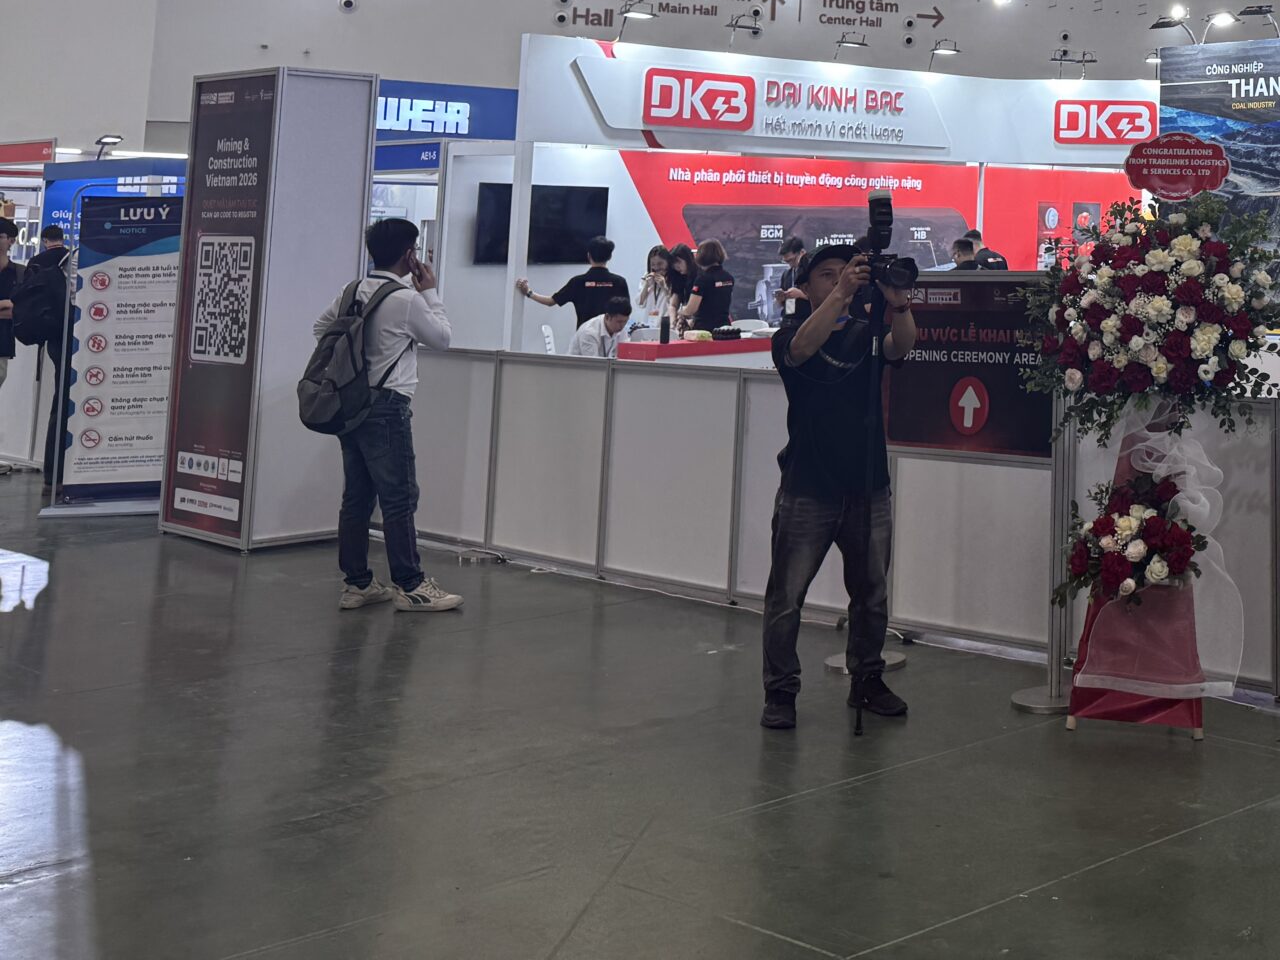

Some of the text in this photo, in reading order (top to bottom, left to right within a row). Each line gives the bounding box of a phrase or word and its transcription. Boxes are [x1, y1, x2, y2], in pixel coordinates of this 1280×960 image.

[572, 7, 614, 28] Hall
[658, 2, 882, 28] Main Hall Center Hall
[1206, 61, 1264, 76] CÔNG NGHIỆP
[809, 84, 857, 111] KINH
[1232, 101, 1276, 110] COAL INDUSTRY
[376, 96, 470, 134] WEIR
[216, 138, 250, 154] Mining &
[1142, 148, 1213, 156] CONGRATULATIONS
[208, 155, 258, 170] Construction
[420, 151, 436, 160] AE1-5
[1129, 158, 1227, 166] FROM TRADELINKS LOGISTICS
[669, 168, 922, 191] Nhà phân phối thiết bị truyền động công nghiệp nặng
[1150, 168, 1180, 176] SERVICES
[206, 172, 258, 188] Vietnam 2026
[120, 204, 170, 221] LƯU Ý
[760, 229, 927, 240] BGM HB
[930, 326, 958, 344] VỰC
[961, 322, 976, 341] LỄ
[980, 328, 1010, 343] KHAI
[950, 350, 1010, 364] CEREMONY
